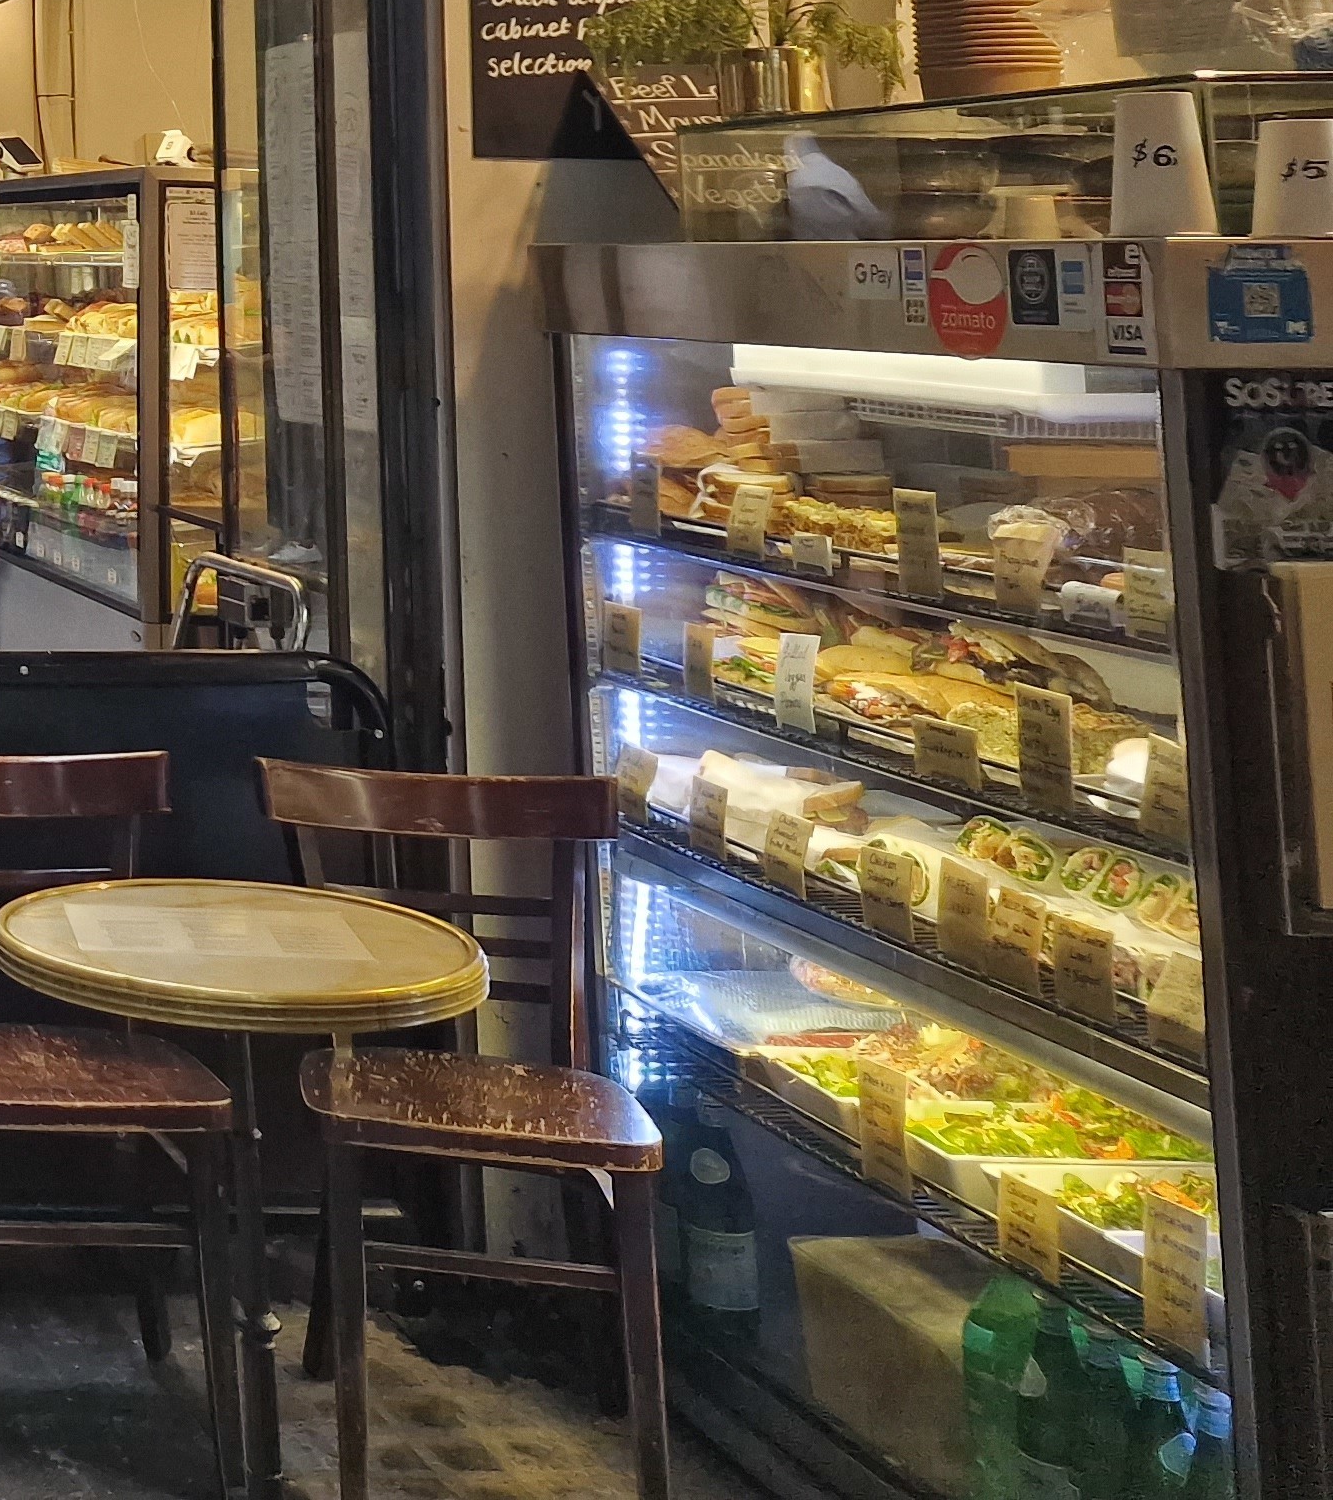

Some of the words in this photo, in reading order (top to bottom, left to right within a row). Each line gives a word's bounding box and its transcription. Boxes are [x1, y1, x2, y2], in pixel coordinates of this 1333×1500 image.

[480, 16, 573, 43] cabinet
[487, 51, 594, 78] selection
[870, 264, 893, 290] Pay
[940, 310, 996, 330] zomato
[1112, 324, 1143, 341] VISA
